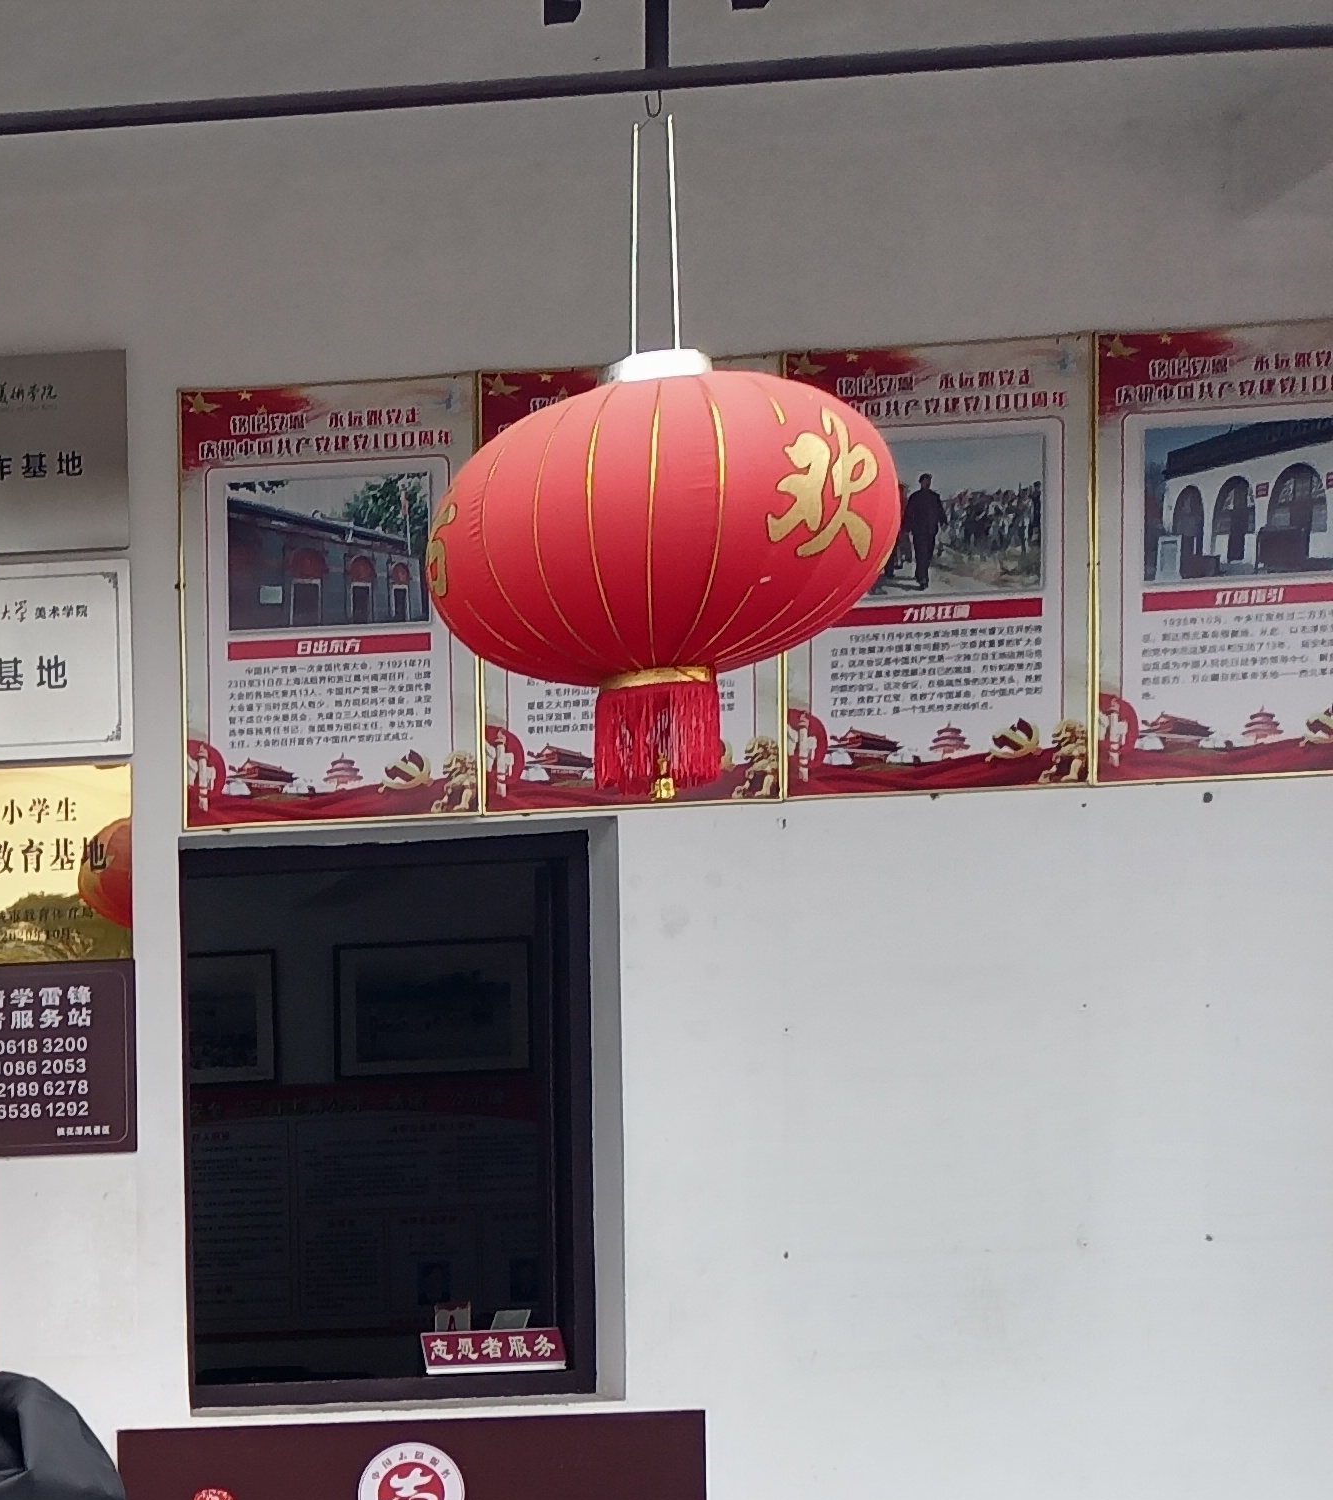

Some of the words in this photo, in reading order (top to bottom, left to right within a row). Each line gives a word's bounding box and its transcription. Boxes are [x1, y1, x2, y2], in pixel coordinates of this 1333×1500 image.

[767, 406, 878, 561] 欢
[430, 1334, 556, 1360] 志愿者服务
